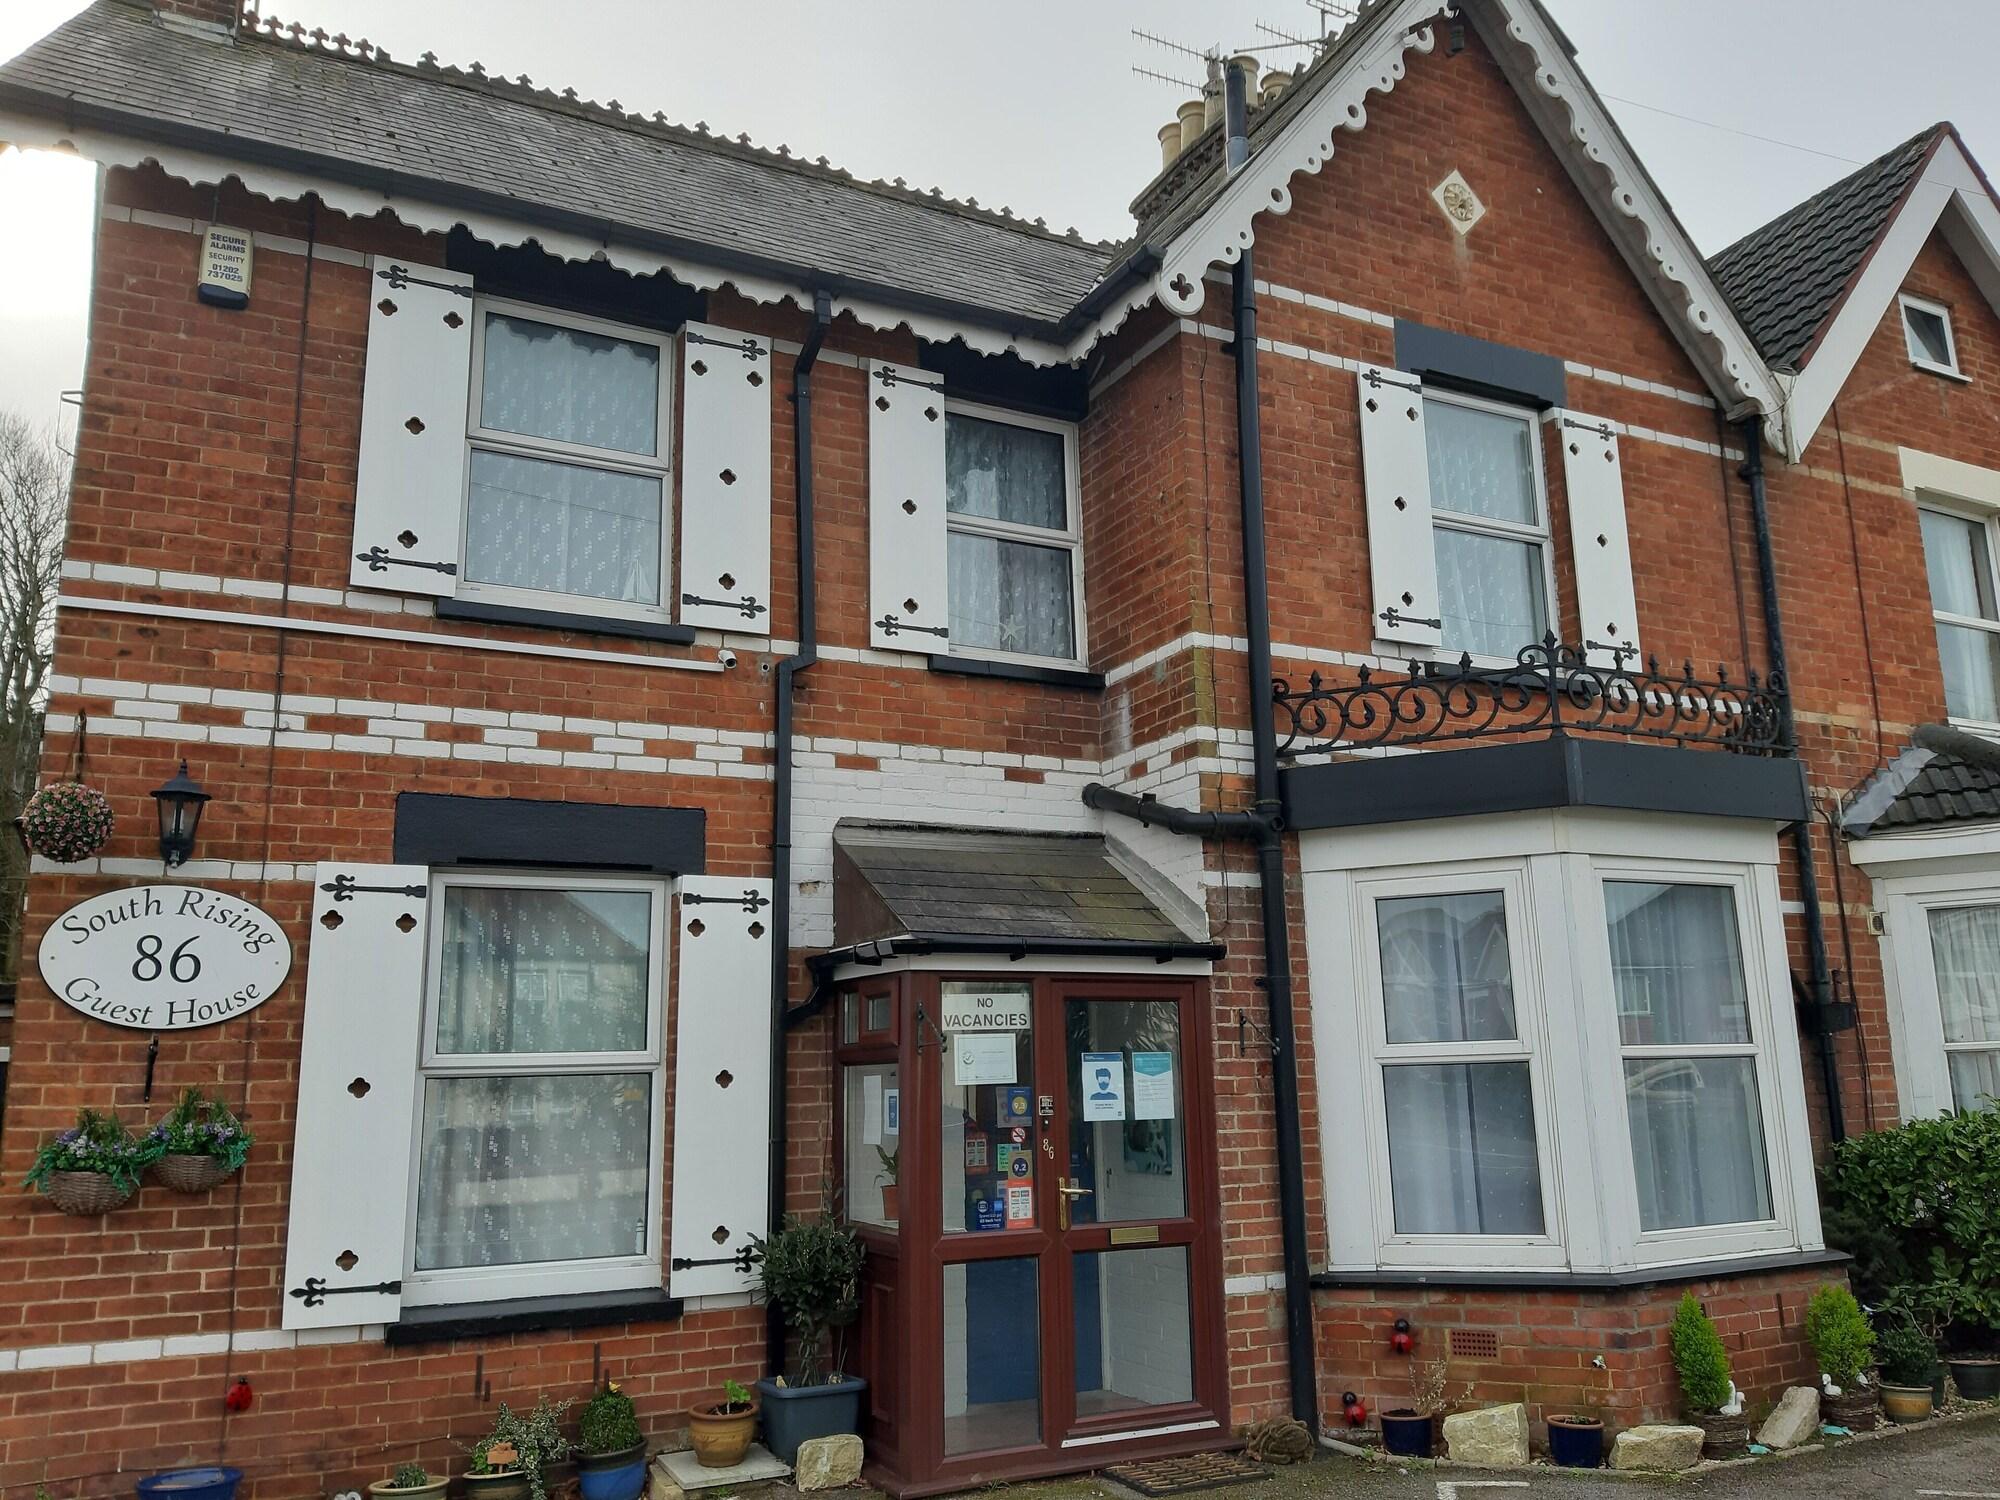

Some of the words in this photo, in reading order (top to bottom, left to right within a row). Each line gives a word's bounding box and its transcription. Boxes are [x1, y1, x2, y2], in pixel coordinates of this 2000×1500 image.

[210, 233, 246, 246] SECURE
[210, 242, 245, 253] ALARMS
[208, 252, 245, 263] SECURITY
[212, 263, 239, 274] 01202
[62, 888, 163, 945] South
[176, 889, 276, 954] Rising
[131, 934, 201, 983] 86
[65, 977, 153, 1025] Guest
[166, 983, 261, 1027] House
[977, 997, 994, 1008] NO
[943, 1013, 1028, 1027] VACANCIES
[1043, 1138, 1054, 1160] 86
[1013, 1163, 1027, 1172] 9.2
